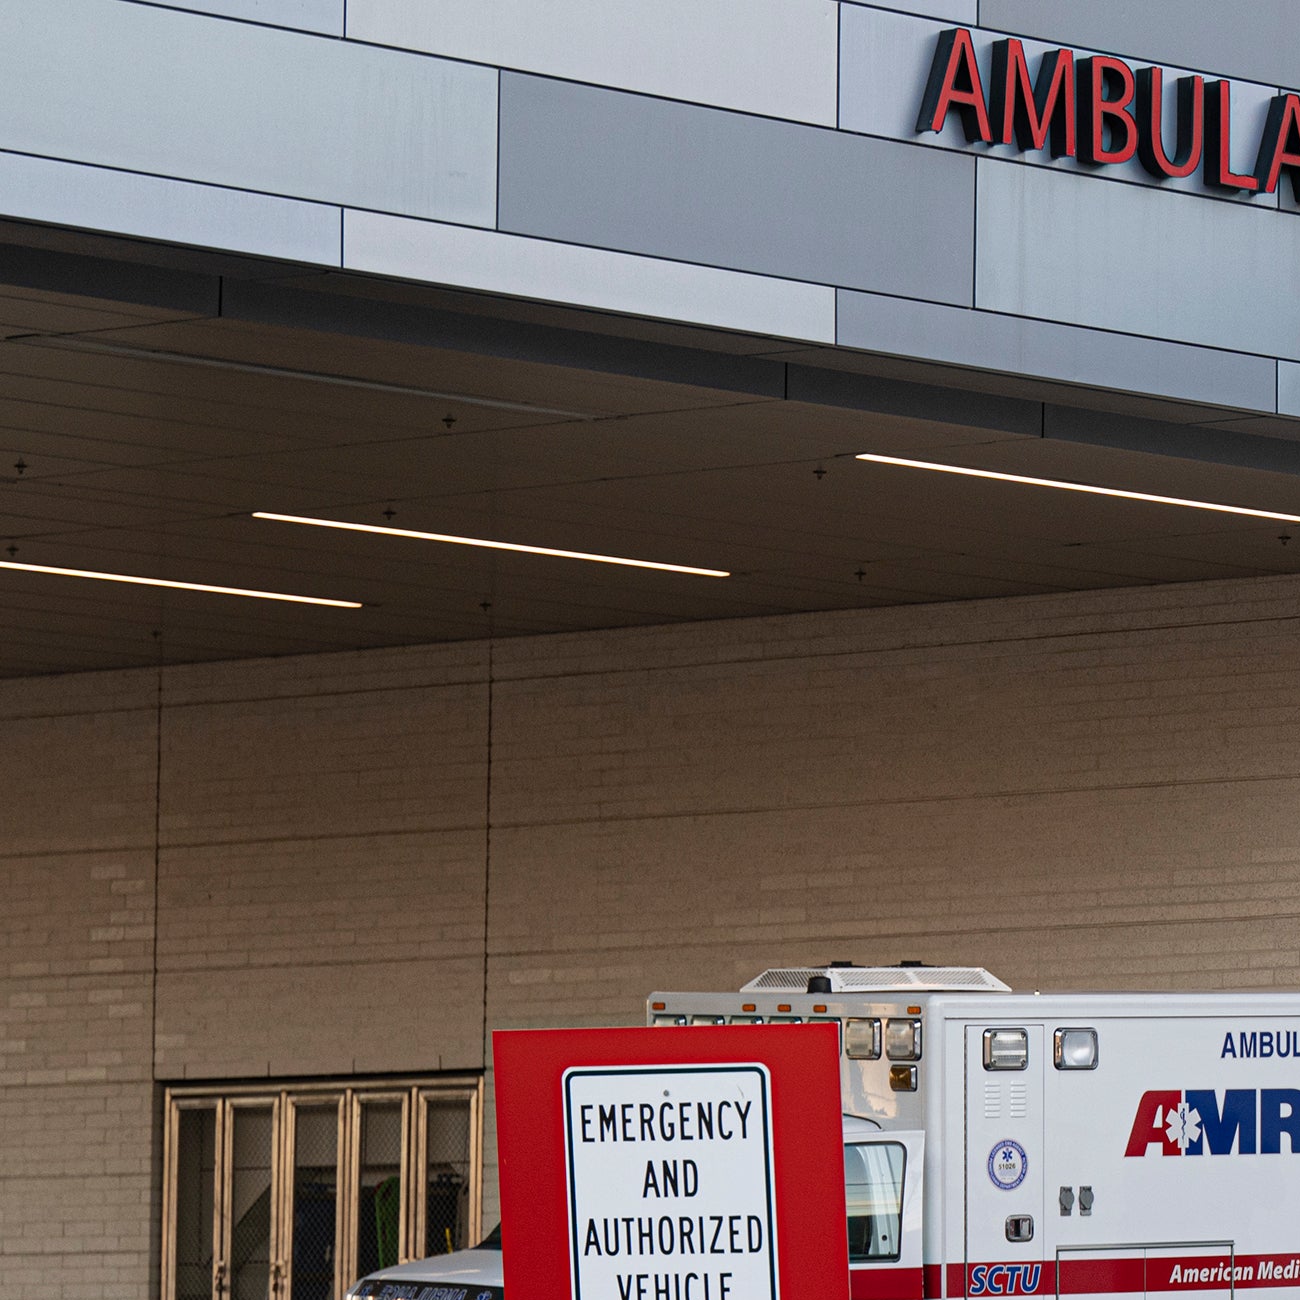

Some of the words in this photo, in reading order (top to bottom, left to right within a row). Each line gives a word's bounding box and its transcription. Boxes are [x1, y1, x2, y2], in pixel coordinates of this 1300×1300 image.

[581, 1100, 752, 1143] EMERGENCY
[642, 1159, 698, 1198] AND
[584, 1215, 763, 1256] AUTHORIZED
[970, 1264, 1041, 1295] SCTU
[1169, 1262, 1254, 1284] American
